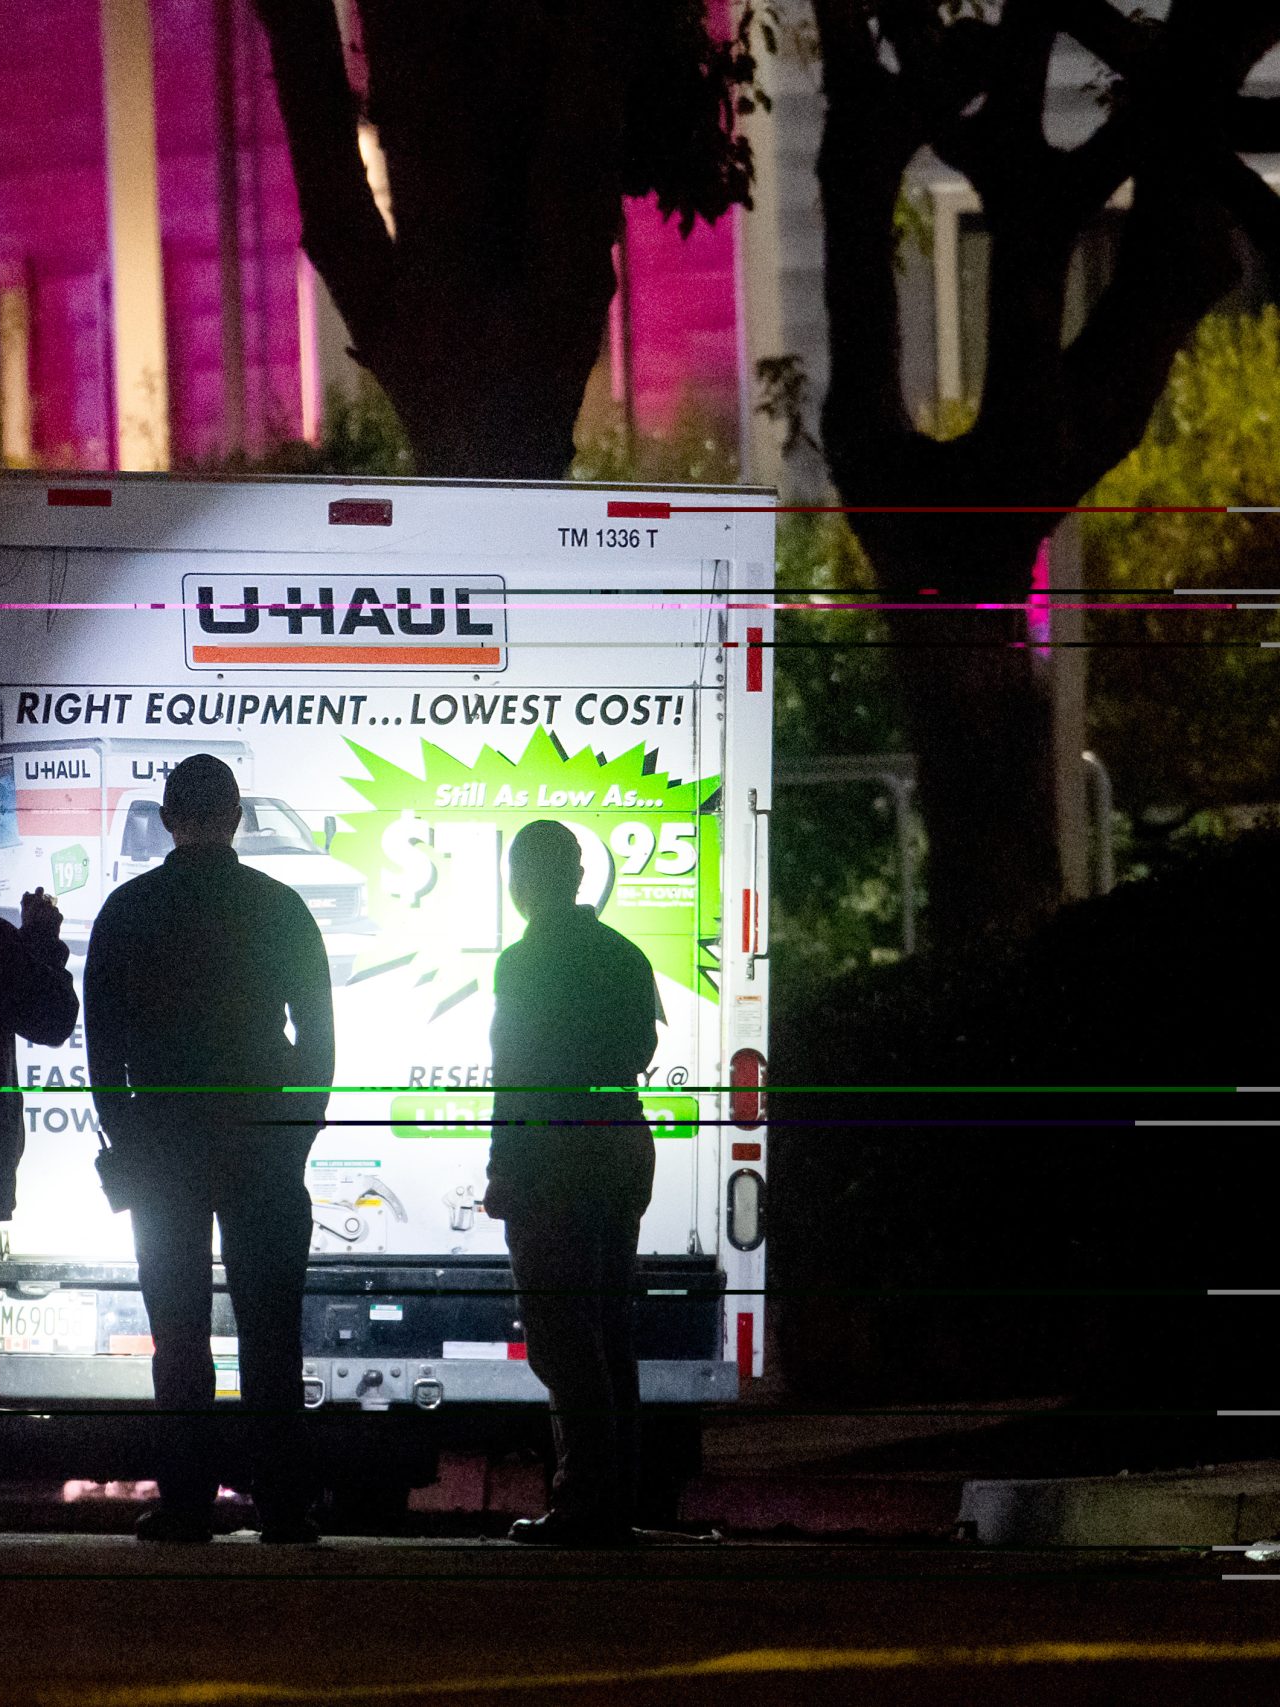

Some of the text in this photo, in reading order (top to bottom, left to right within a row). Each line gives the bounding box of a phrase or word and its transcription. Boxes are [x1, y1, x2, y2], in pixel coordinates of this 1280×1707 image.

[558, 528, 658, 548] TM 1336 T
[16, 692, 132, 725] RIGHT
[409, 693, 562, 726] LOWEST
[574, 693, 684, 726] COST!
[25, 759, 91, 780] U-HAUL
[434, 782, 664, 808] Still As Low As...
[27, 1065, 87, 1091] EAS
